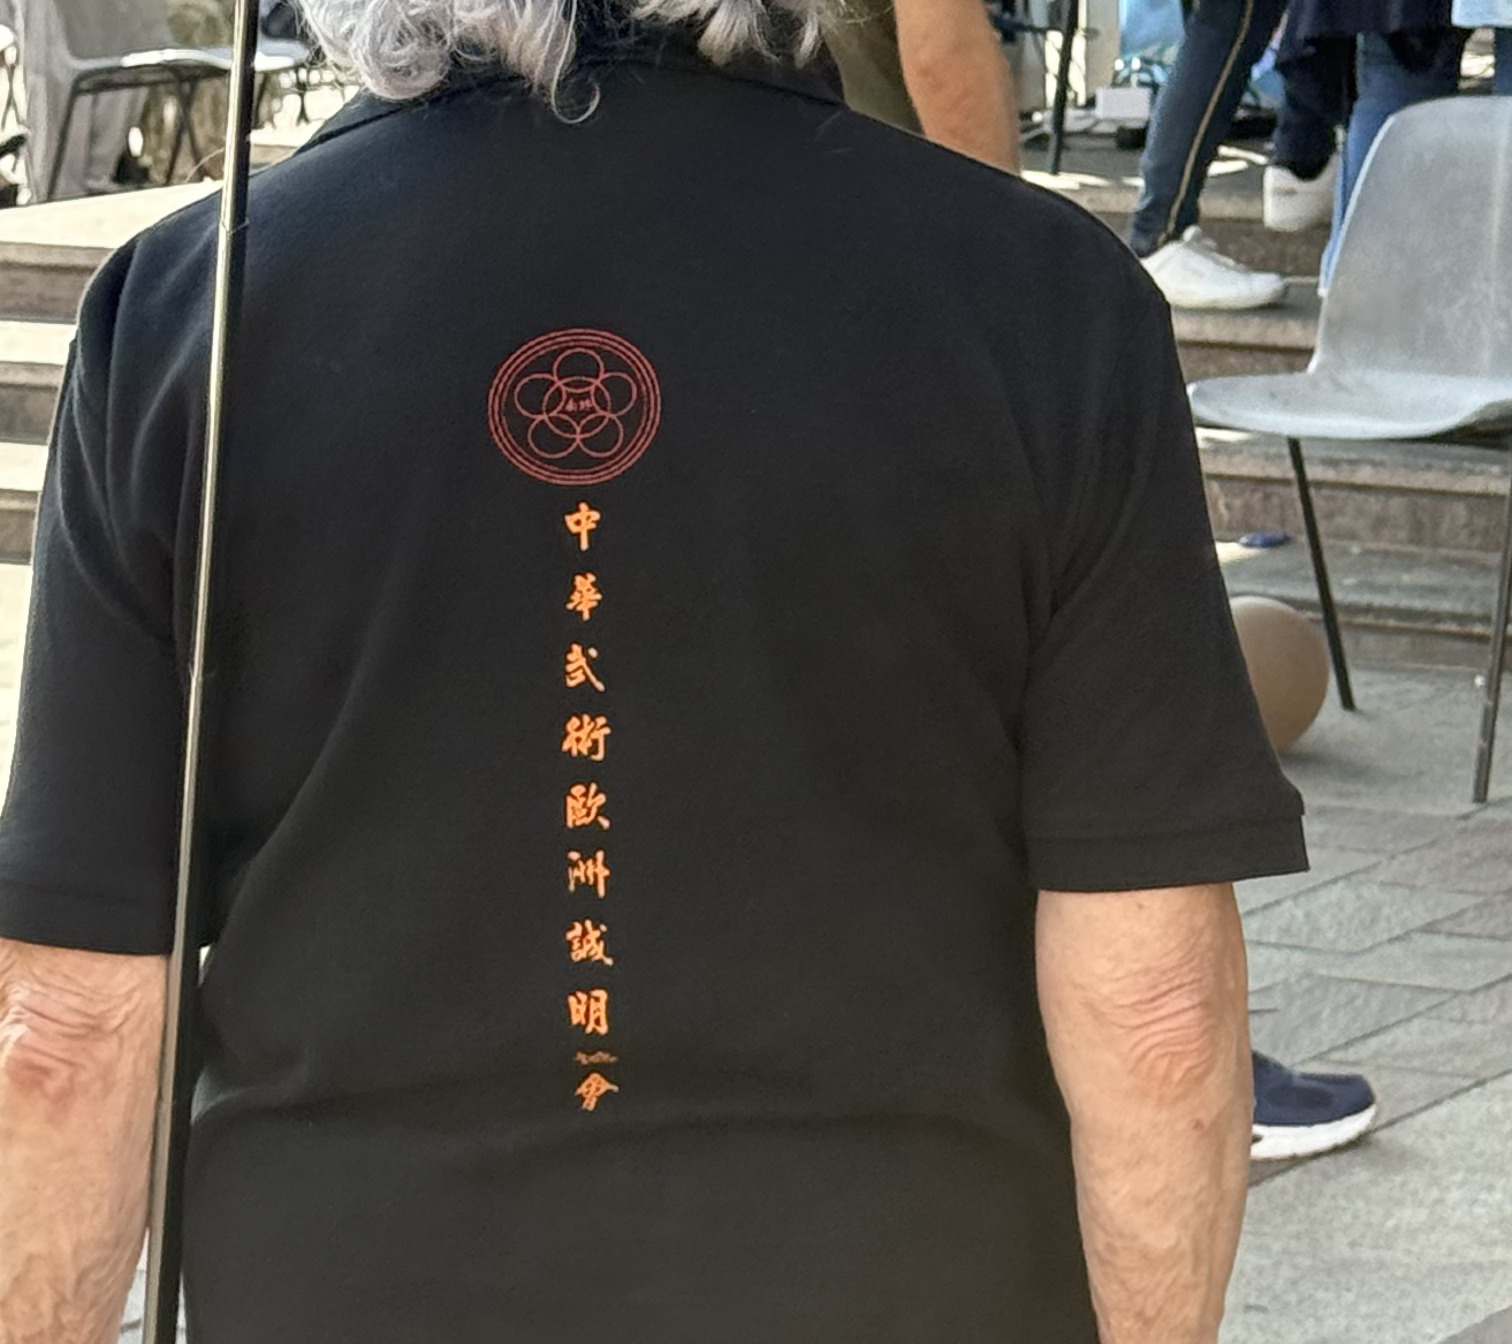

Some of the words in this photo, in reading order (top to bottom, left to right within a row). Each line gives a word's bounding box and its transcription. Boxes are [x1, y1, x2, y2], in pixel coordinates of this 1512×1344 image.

[562, 502, 619, 1112] 中華武術歐洲誠明會
